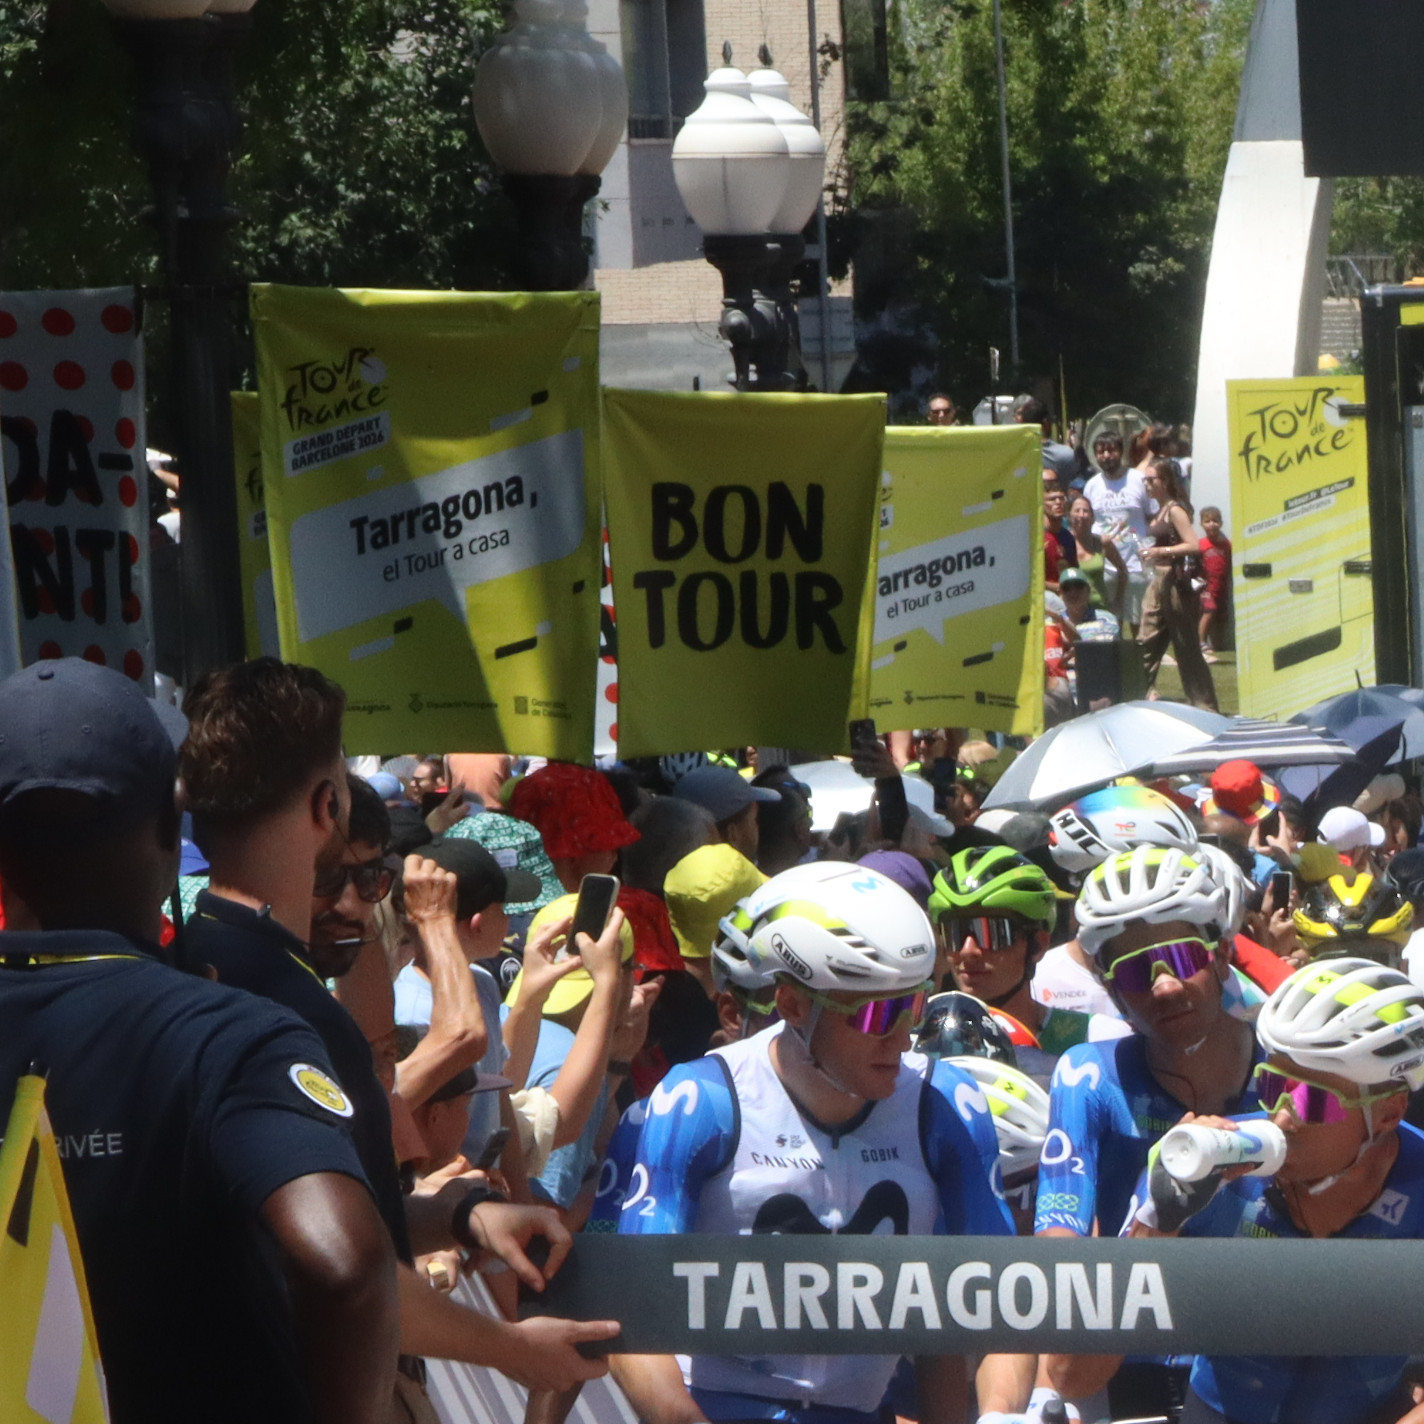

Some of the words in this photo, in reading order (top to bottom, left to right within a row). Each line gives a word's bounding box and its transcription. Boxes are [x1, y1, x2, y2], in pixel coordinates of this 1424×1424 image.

[289, 347, 375, 398] TOUR
[281, 385, 387, 432] france
[1247, 387, 1341, 444] TOUR
[291, 440, 357, 471] BARCELONE
[359, 431, 385, 449] 2026
[293, 429, 334, 456] GRAND
[1239, 428, 1352, 482] france
[350, 474, 539, 556] Tarragona,
[651, 481, 824, 566] BON
[383, 559, 400, 583] el
[405, 546, 447, 576] Tour
[452, 542, 465, 561] a
[468, 528, 511, 557] casa
[634, 568, 848, 654] TOUR
[887, 604, 899, 619] el
[903, 594, 931, 613] Tour
[935, 589, 943, 603] a
[947, 579, 976, 599] casa
[774, 939, 809, 979] ABUS
[861, 1147, 899, 1163] GOBIK
[672, 1261, 1174, 1331] TARRAGONA
